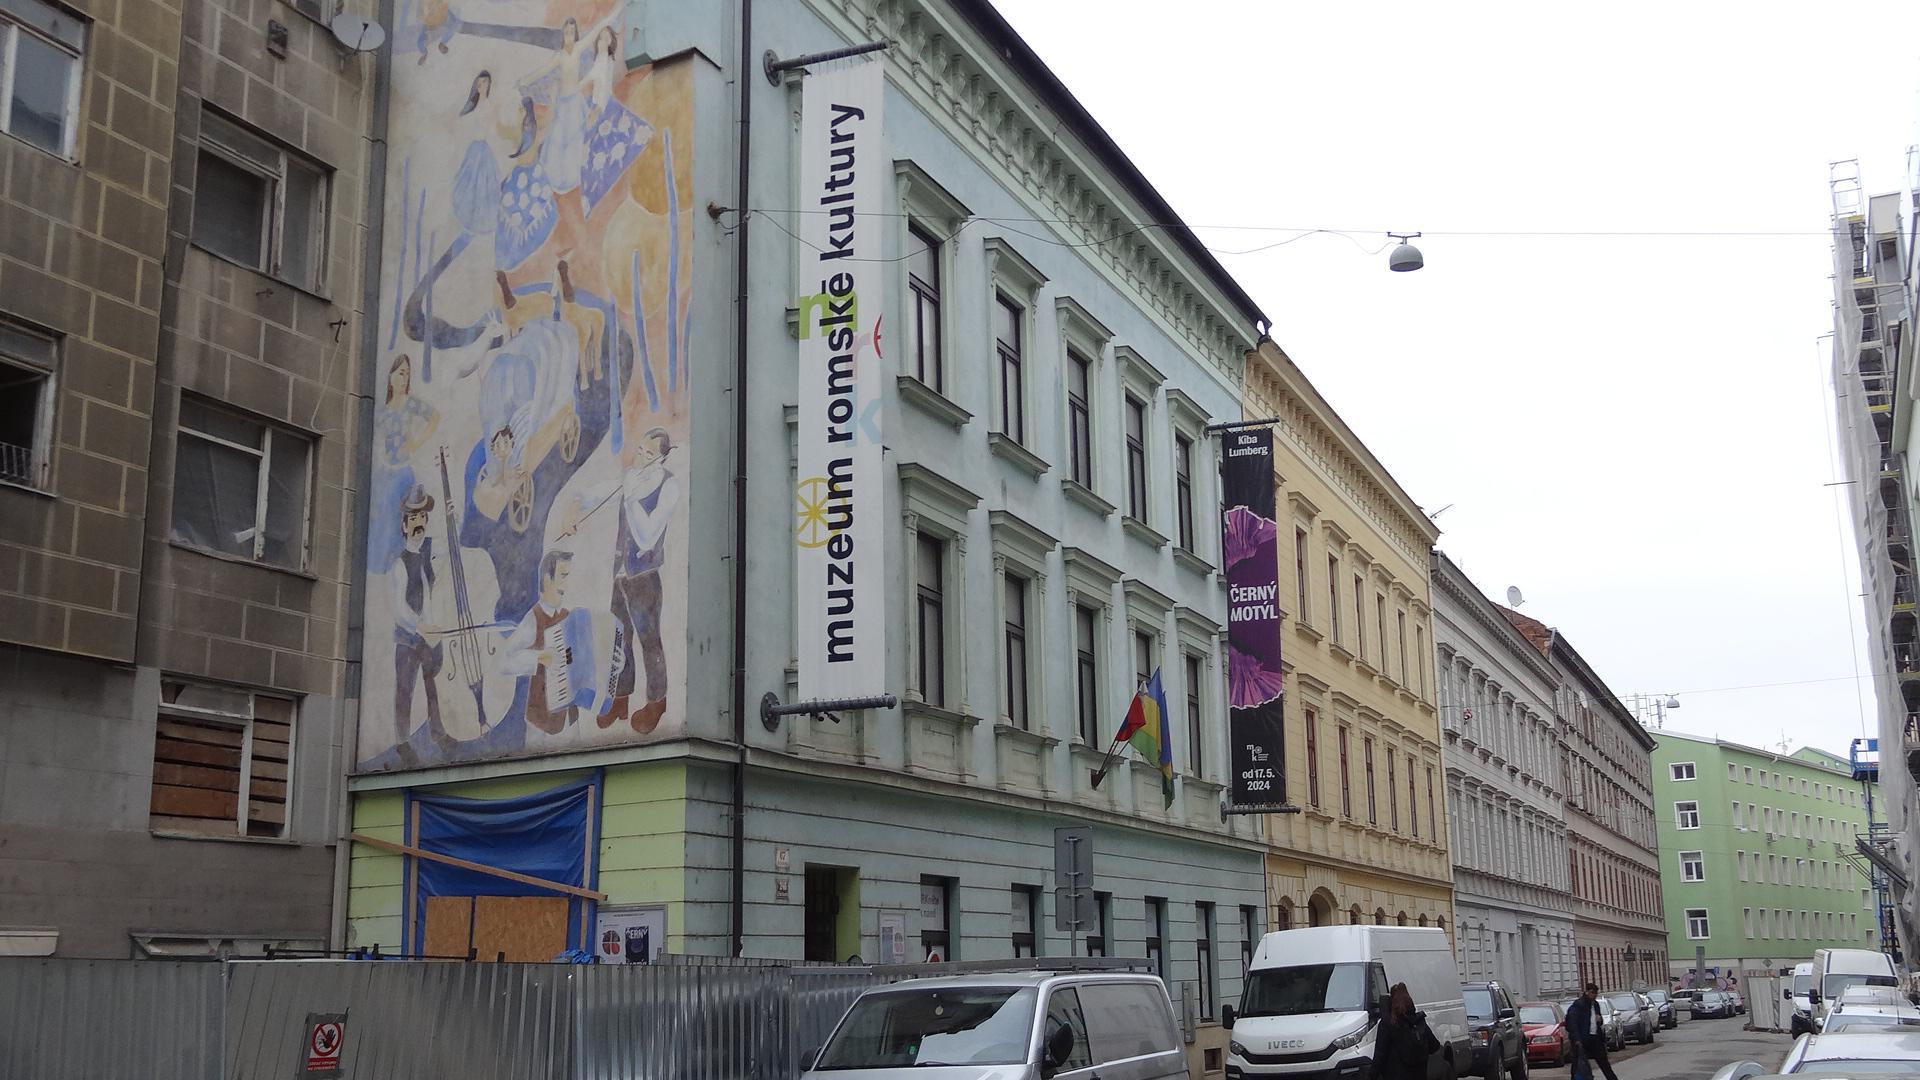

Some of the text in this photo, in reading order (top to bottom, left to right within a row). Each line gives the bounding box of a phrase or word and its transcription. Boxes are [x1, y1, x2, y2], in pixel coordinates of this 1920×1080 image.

[819, 103, 864, 261] kultury
[1238, 435, 1258, 445] Kiba
[1228, 446, 1269, 457] Lumberg
[827, 457, 854, 663] muzeum
[1229, 581, 1277, 603] ČERNÝ
[1230, 601, 1278, 622] MOTÝL
[1242, 769, 1254, 779] od
[1247, 780, 1271, 791] 2024
[1267, 1039, 1305, 1050] IVECO
